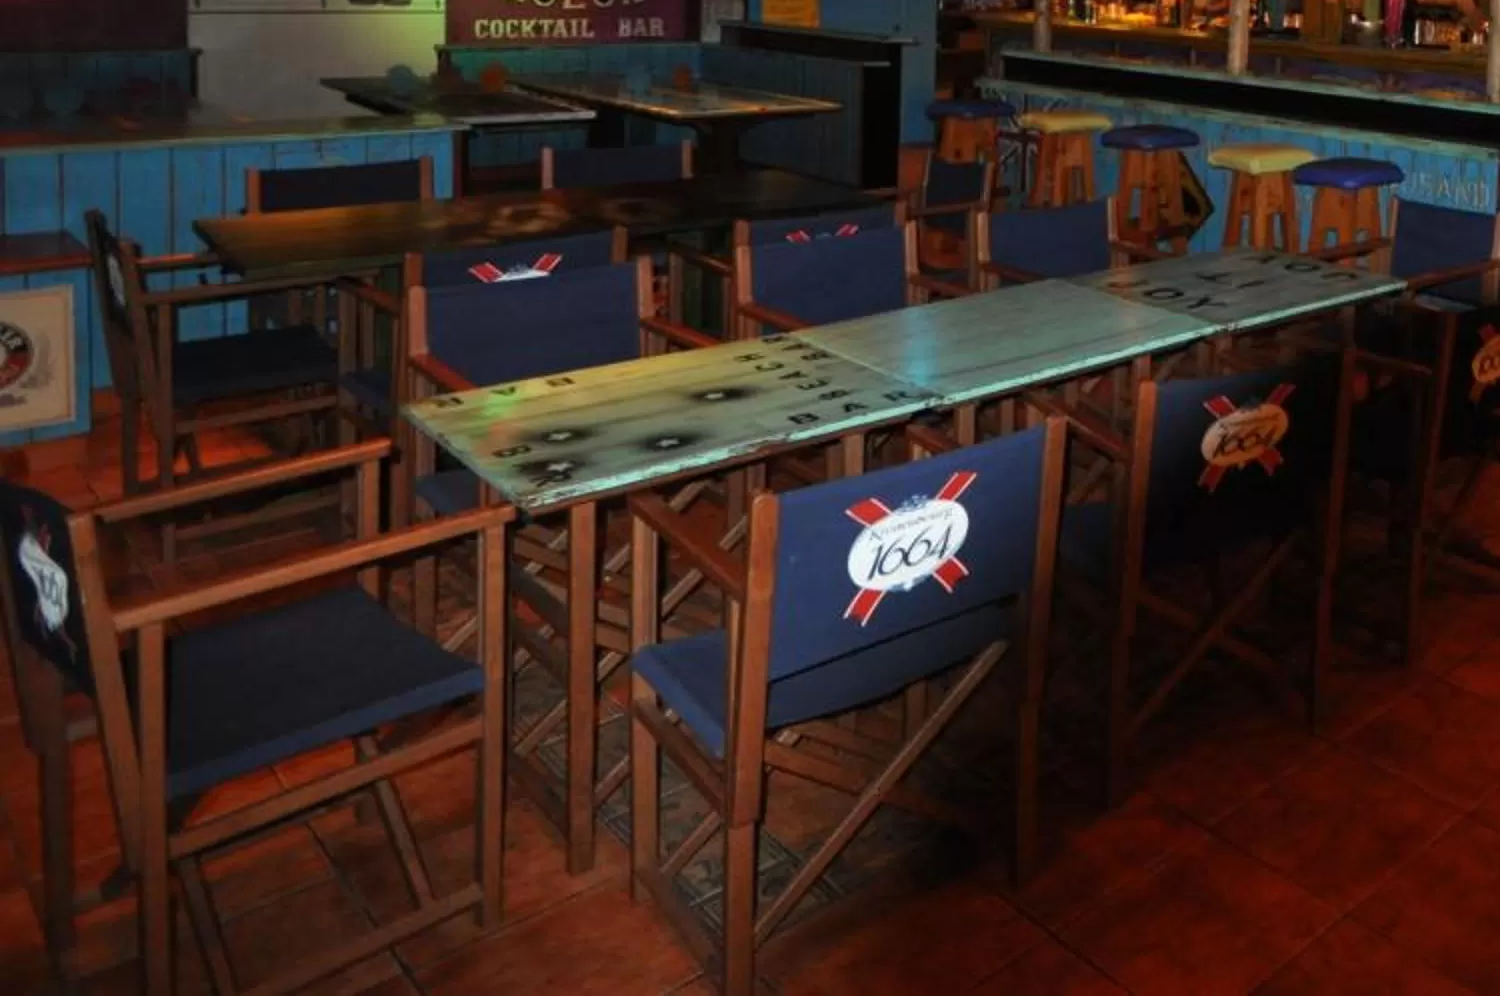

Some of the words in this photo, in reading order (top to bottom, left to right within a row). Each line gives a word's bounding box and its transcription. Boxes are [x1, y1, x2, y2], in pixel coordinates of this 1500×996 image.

[474, 17, 595, 40] COCKTAIL
[618, 16, 665, 38] BAR
[733, 352, 851, 401] BEACH
[787, 390, 913, 425] BAR
[867, 524, 952, 581] 1664
